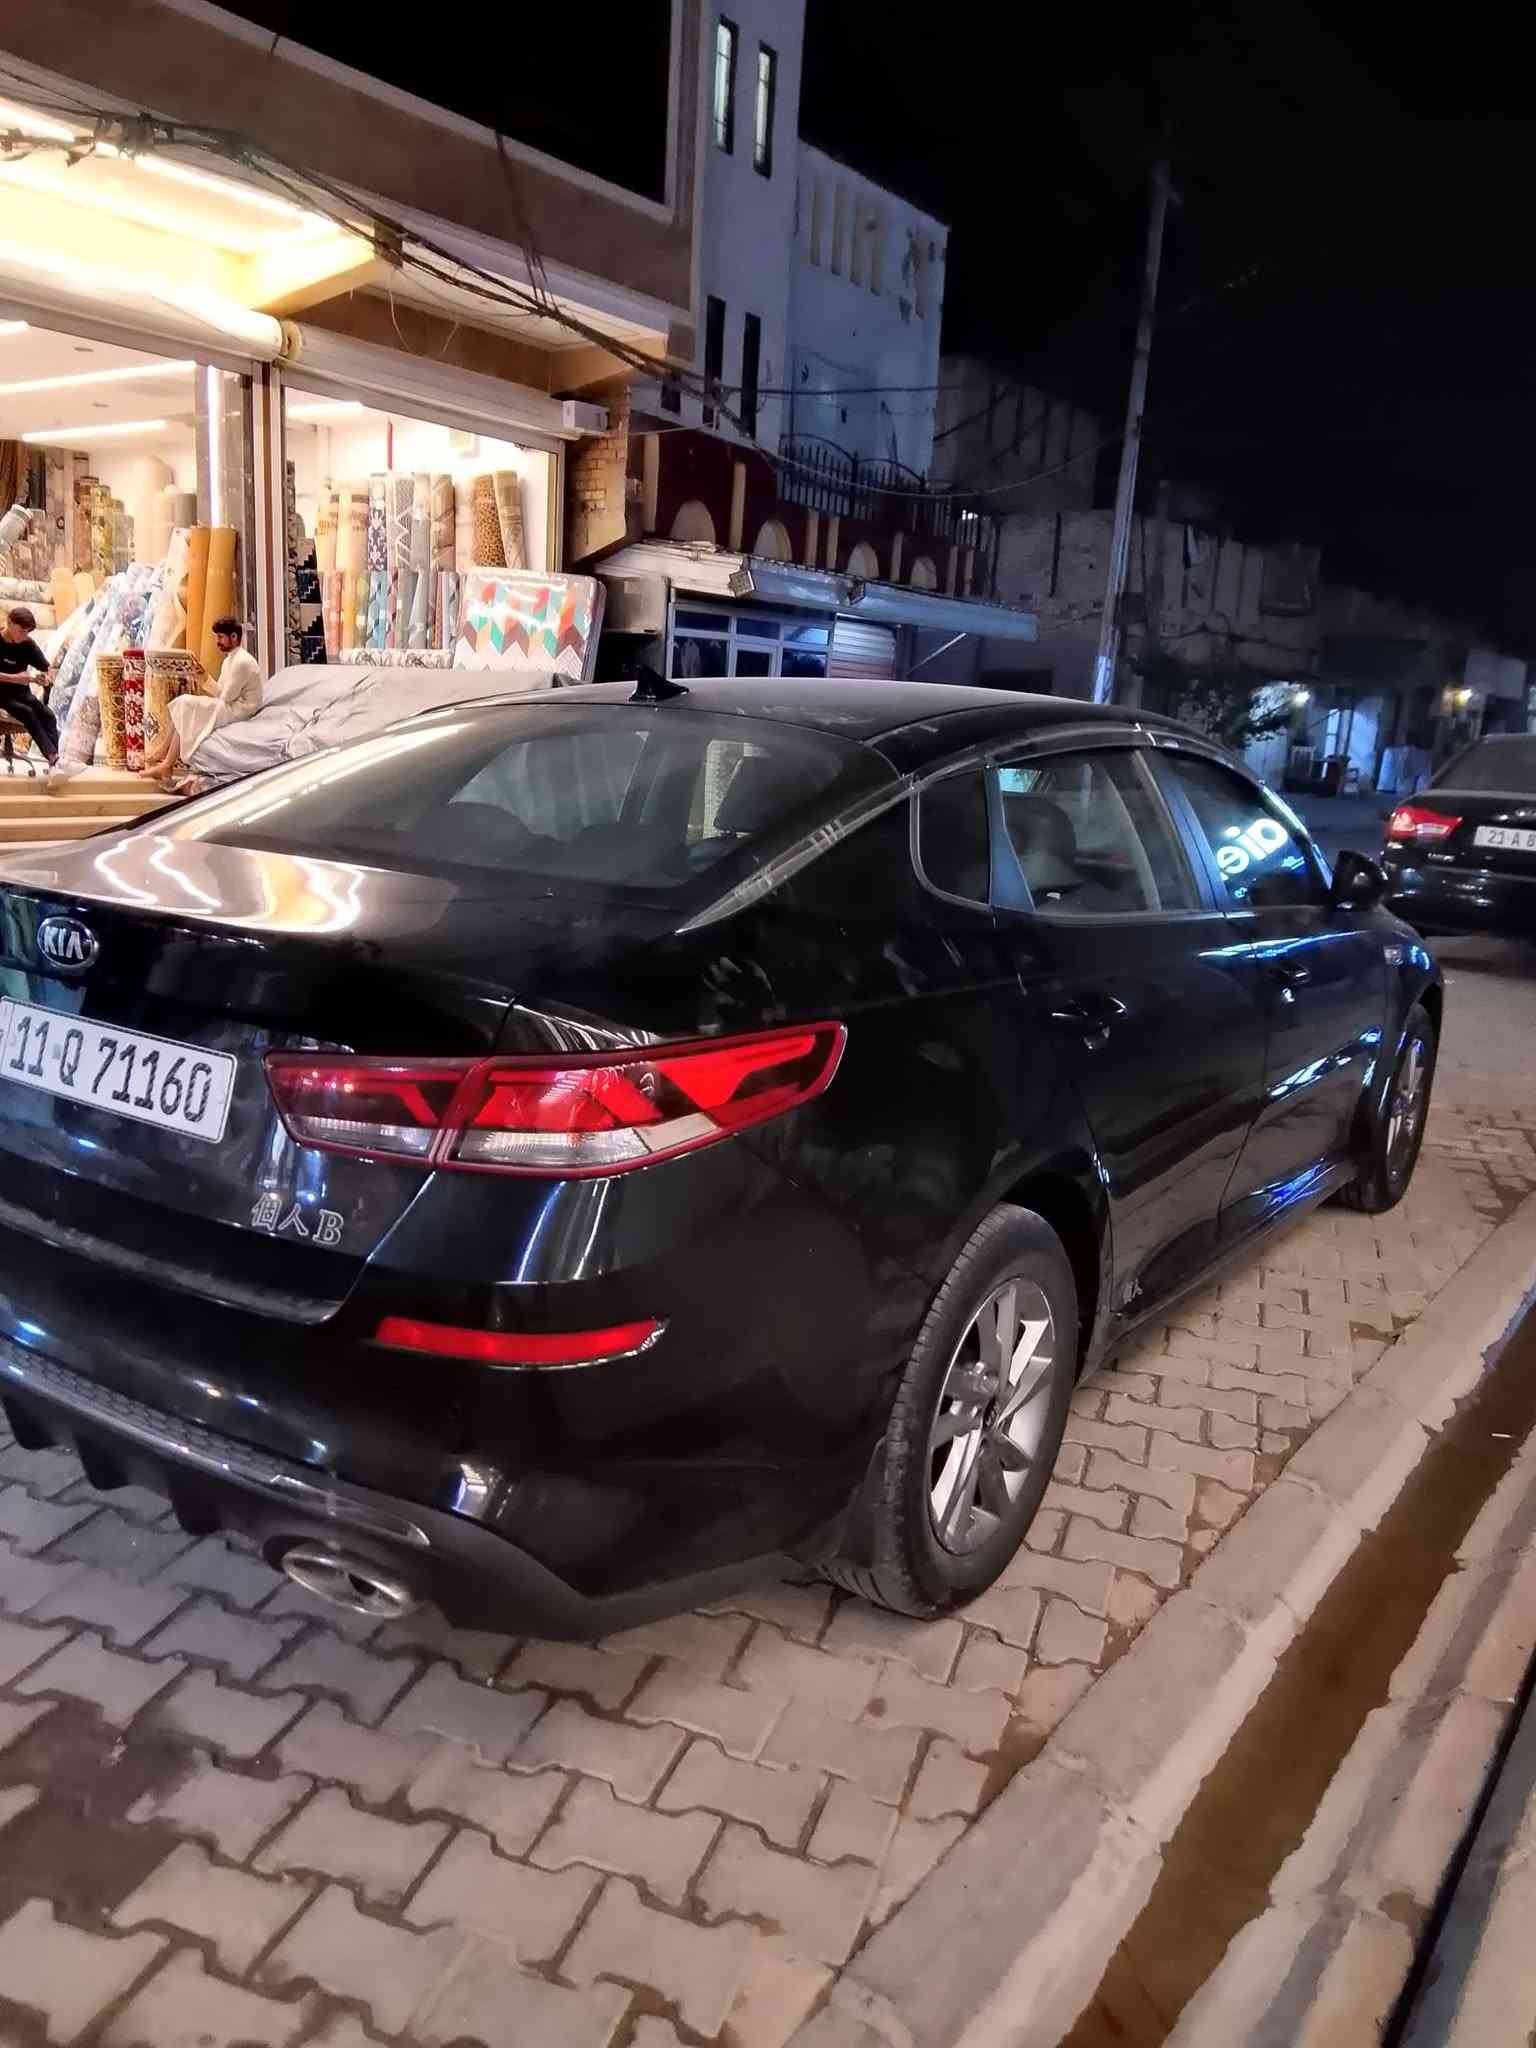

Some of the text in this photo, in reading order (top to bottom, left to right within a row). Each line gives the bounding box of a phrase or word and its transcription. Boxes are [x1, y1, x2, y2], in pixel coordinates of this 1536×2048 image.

[1511, 832, 1520, 847] A
[44, 926, 84, 960] KIA
[10, 1016, 212, 1123] 11 Q 71160
